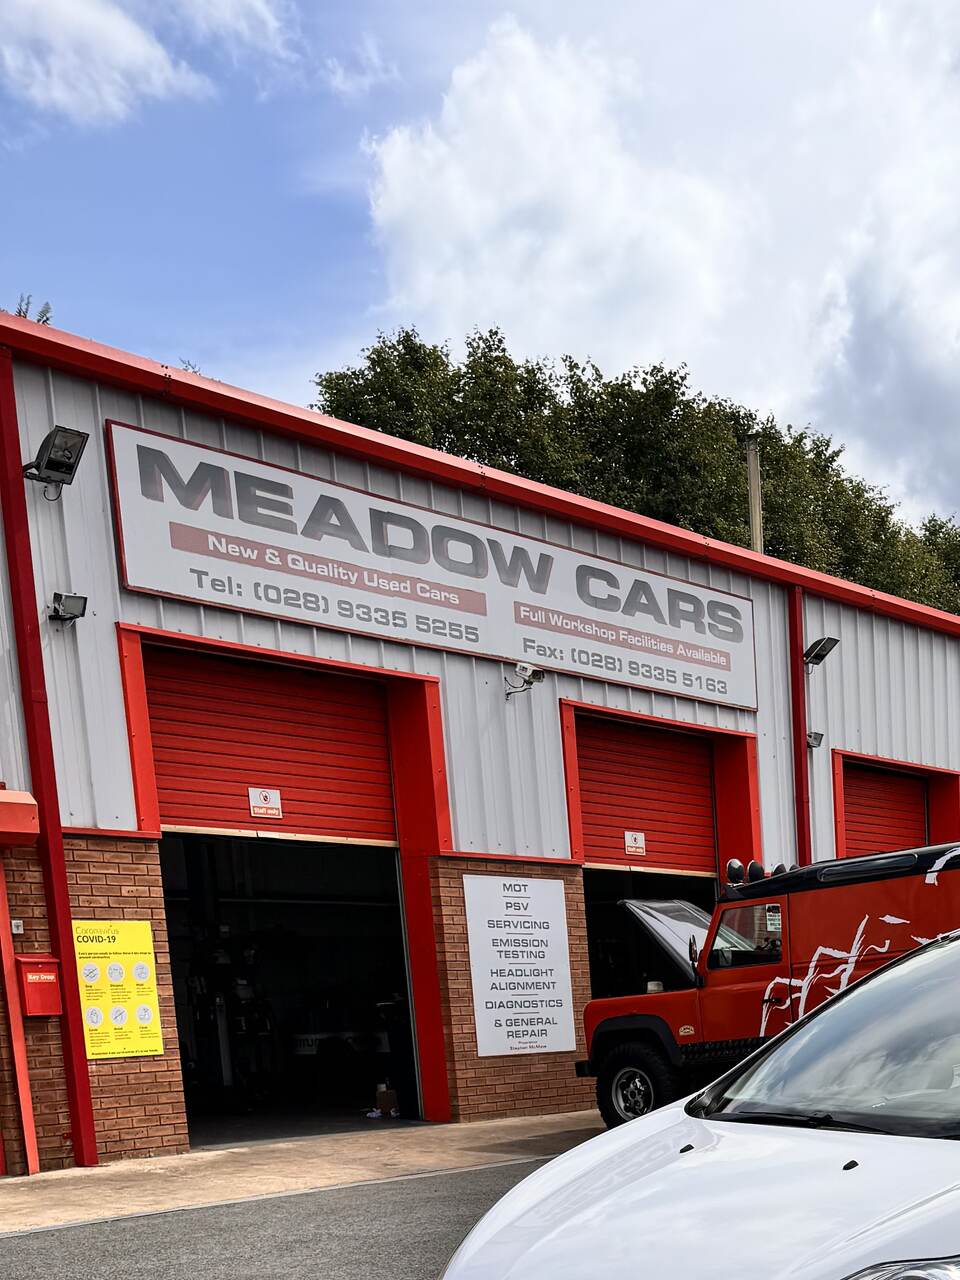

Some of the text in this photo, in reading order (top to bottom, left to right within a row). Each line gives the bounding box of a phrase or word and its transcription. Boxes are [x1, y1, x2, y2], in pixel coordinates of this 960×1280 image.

[136, 443, 744, 643] MEADOW CARS
[207, 534, 460, 605] New & Quality Used Cars
[189, 568, 480, 643] Tel: (028) 9335 5255
[519, 606, 727, 666] Full Workshop Facilities Available
[522, 637, 728, 695] Fax: (028) 9335 5163
[502, 883, 528, 893] MOT
[505, 902, 529, 911] PSV
[487, 919, 550, 930] SERVICING
[75, 926, 120, 935] Coronavirus
[76, 935, 116, 944] COVID-19
[491, 938, 549, 948] EMISSION
[496, 950, 546, 959] TESTING
[490, 968, 554, 978] HEADLIGHT
[490, 981, 557, 991] ALIGNMENT
[485, 999, 563, 1010] DIAGNOSTICS
[494, 1016, 558, 1028] & GENERAL
[506, 1029, 548, 1039] REPAIR
